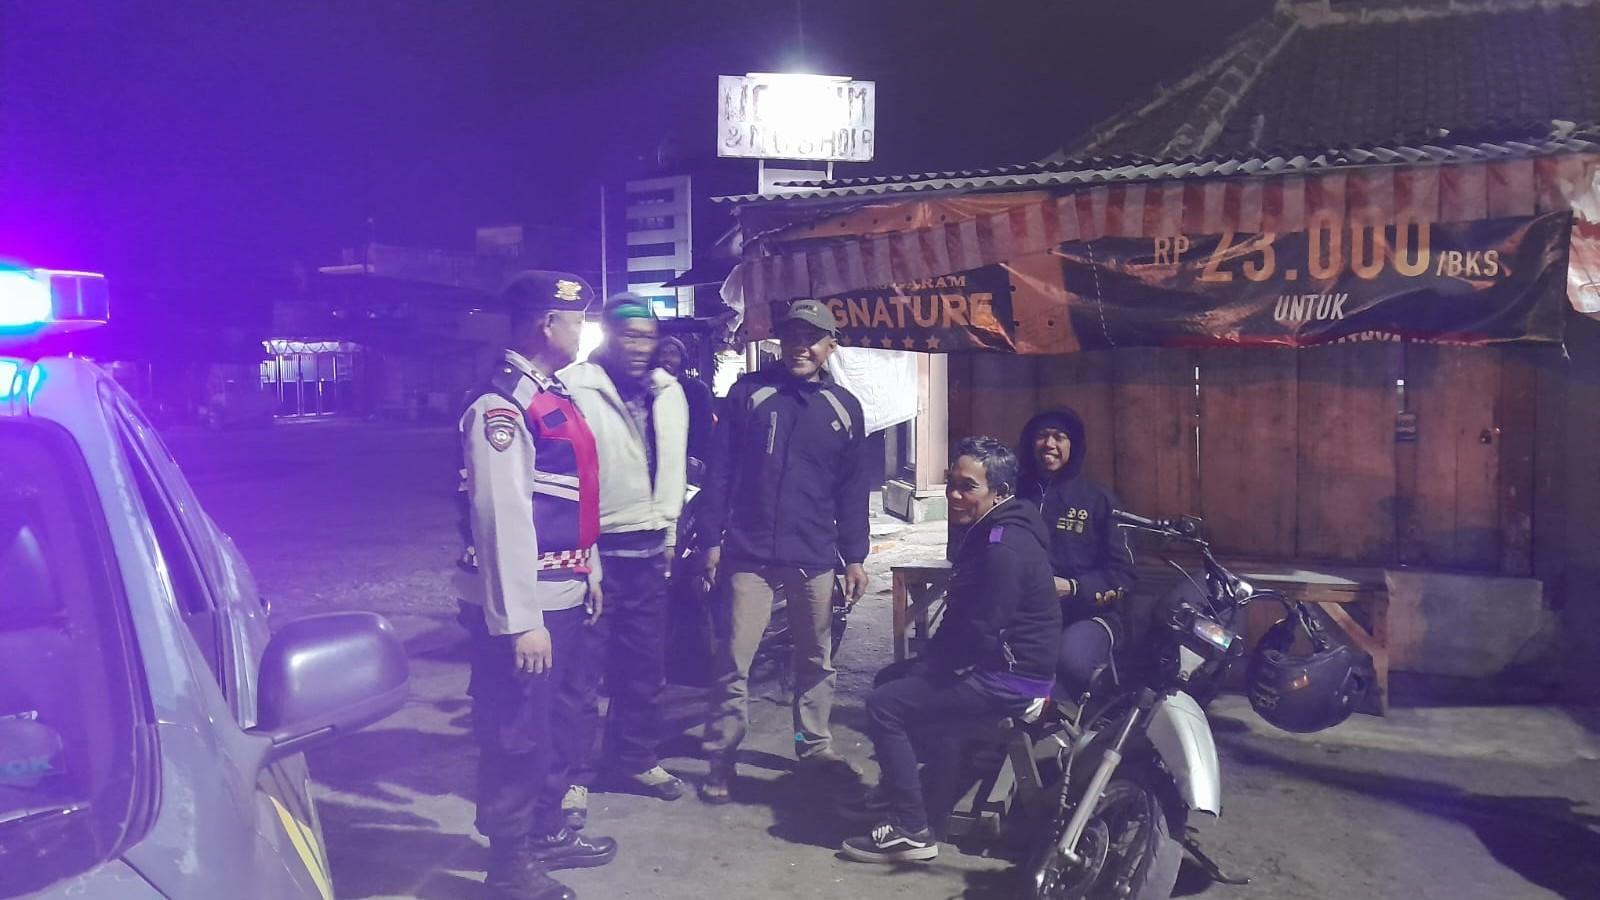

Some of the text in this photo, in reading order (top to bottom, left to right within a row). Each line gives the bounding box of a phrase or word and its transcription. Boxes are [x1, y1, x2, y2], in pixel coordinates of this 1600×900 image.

[1153, 208, 1500, 283] RP 23.000 /BKS
[827, 292, 993, 330] GNATURE
[1273, 292, 1349, 321] UNTUK
